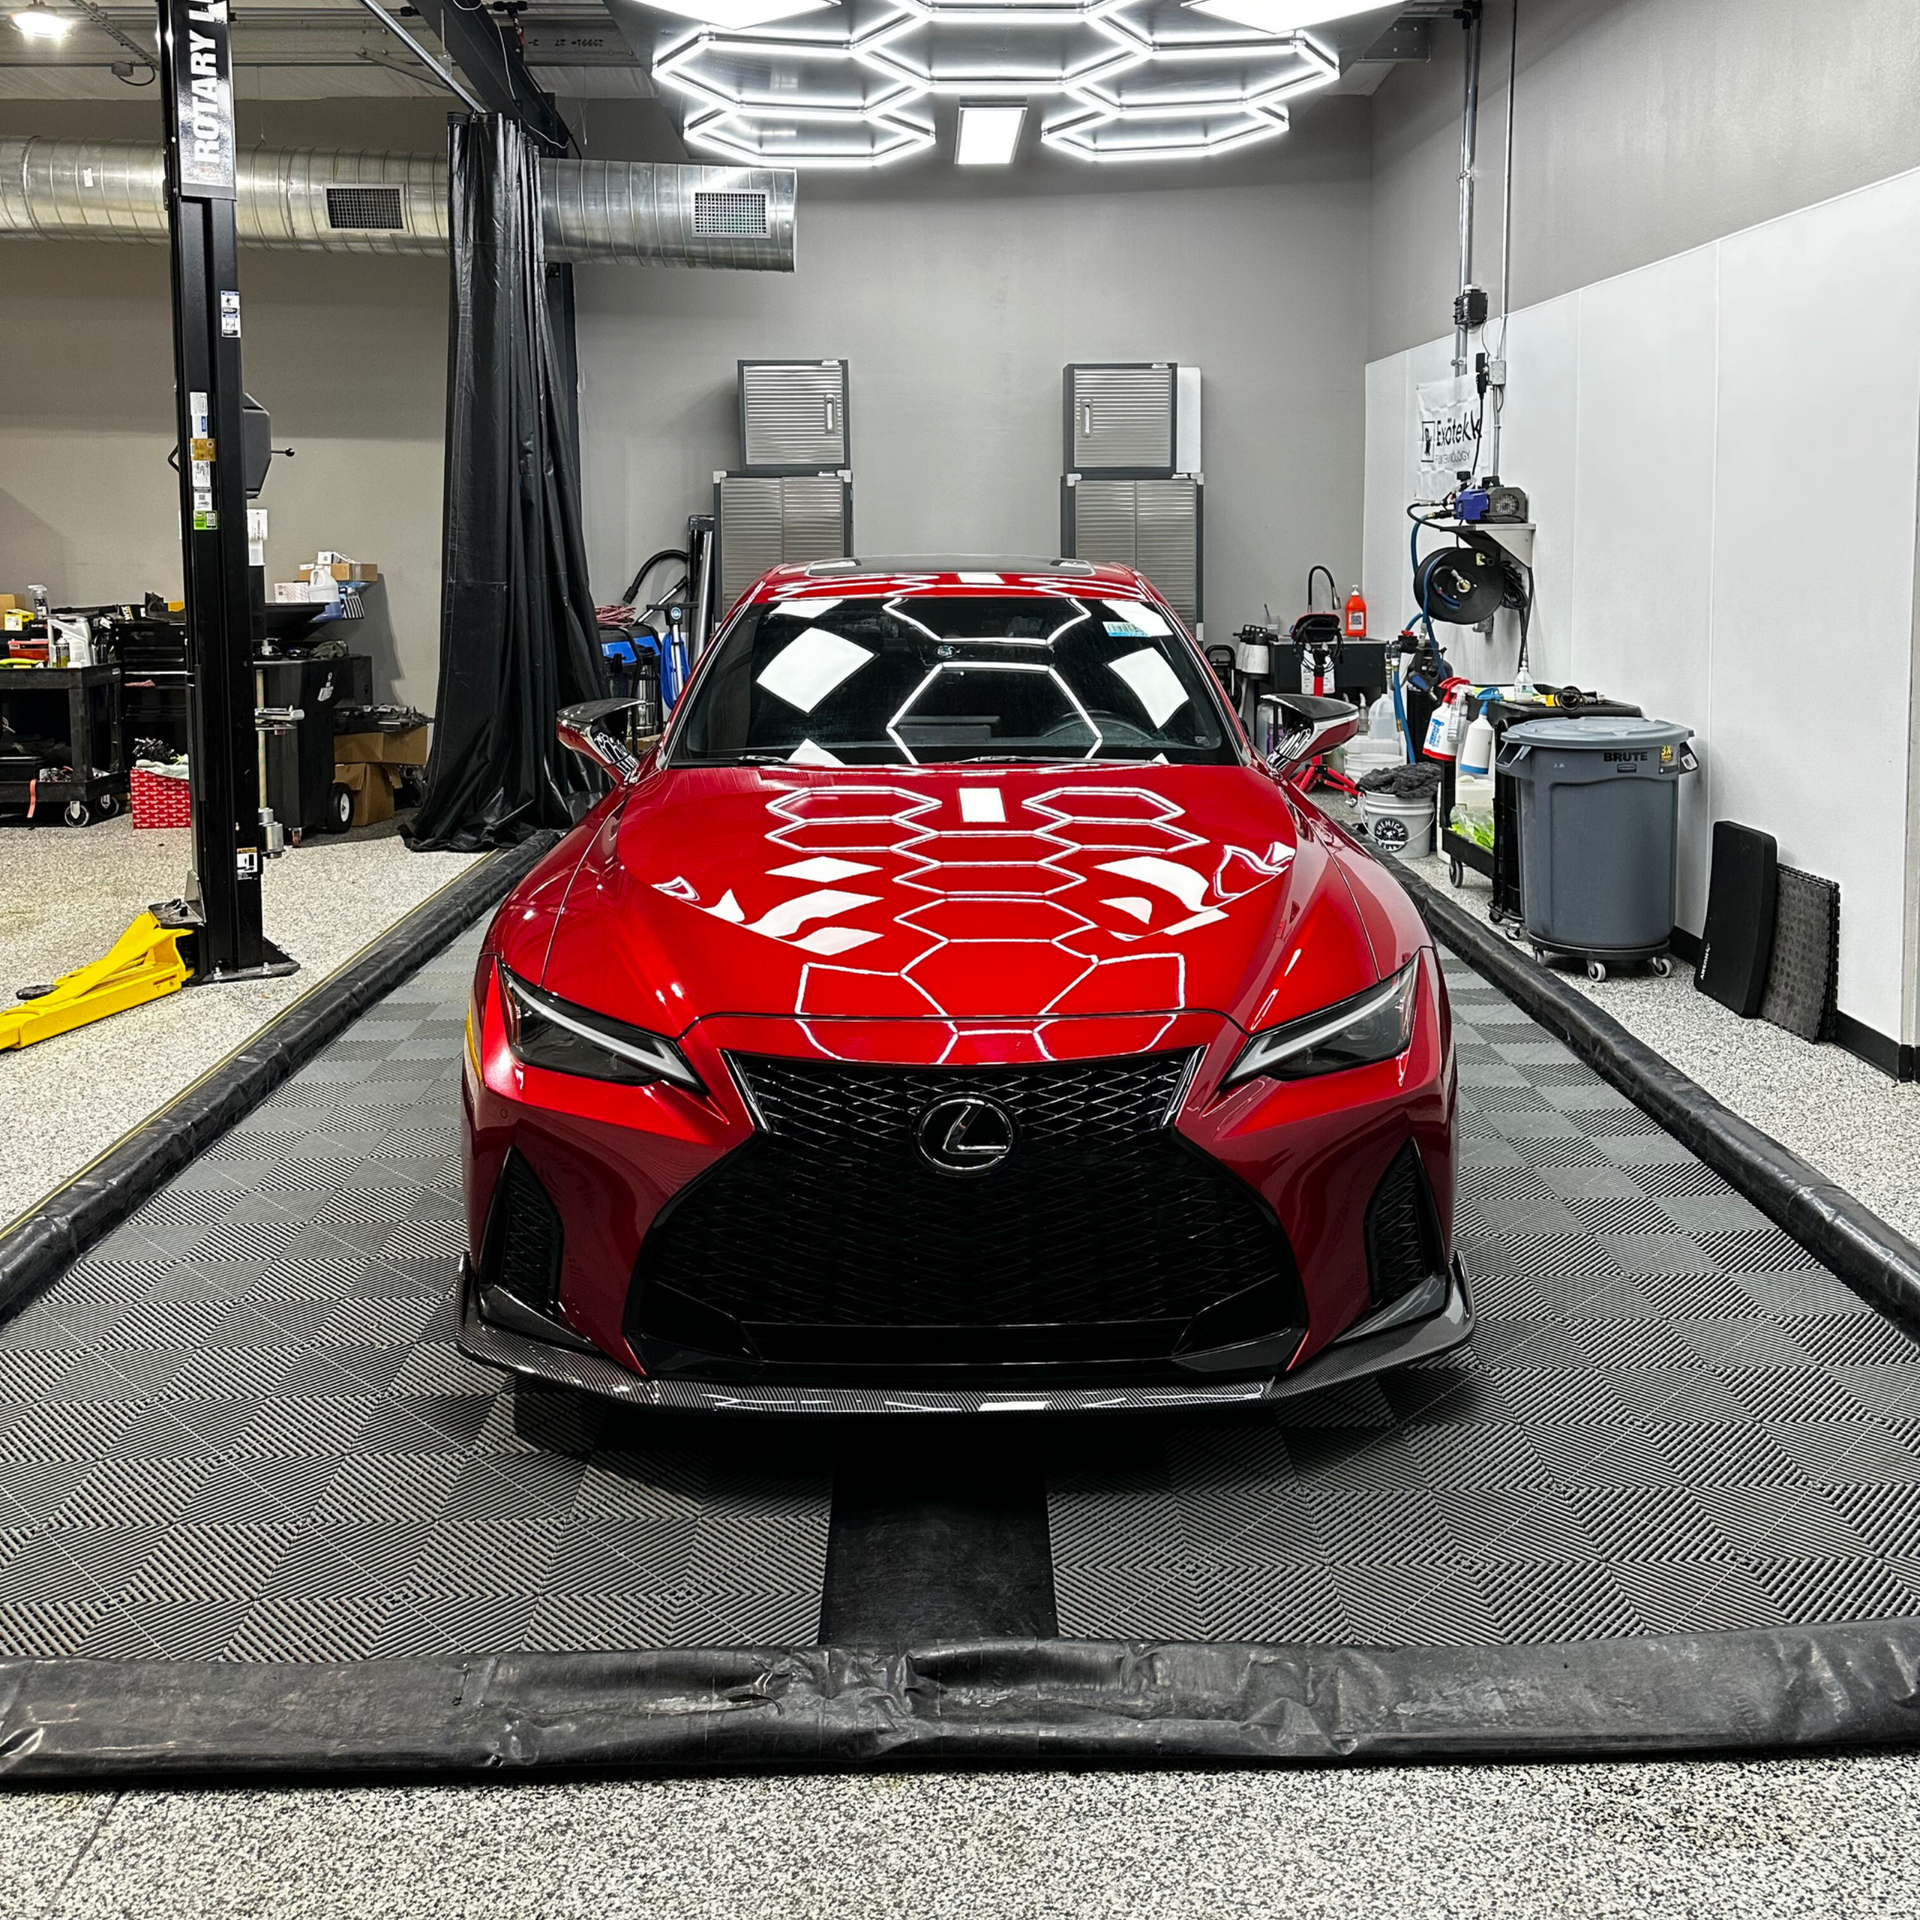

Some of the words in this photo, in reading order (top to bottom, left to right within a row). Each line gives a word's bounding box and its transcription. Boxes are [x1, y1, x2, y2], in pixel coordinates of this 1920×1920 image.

[188, 29, 221, 164] ROTARY
[1603, 751, 1648, 762] BRUTE
[1375, 820, 1406, 837] CHEMICAL
